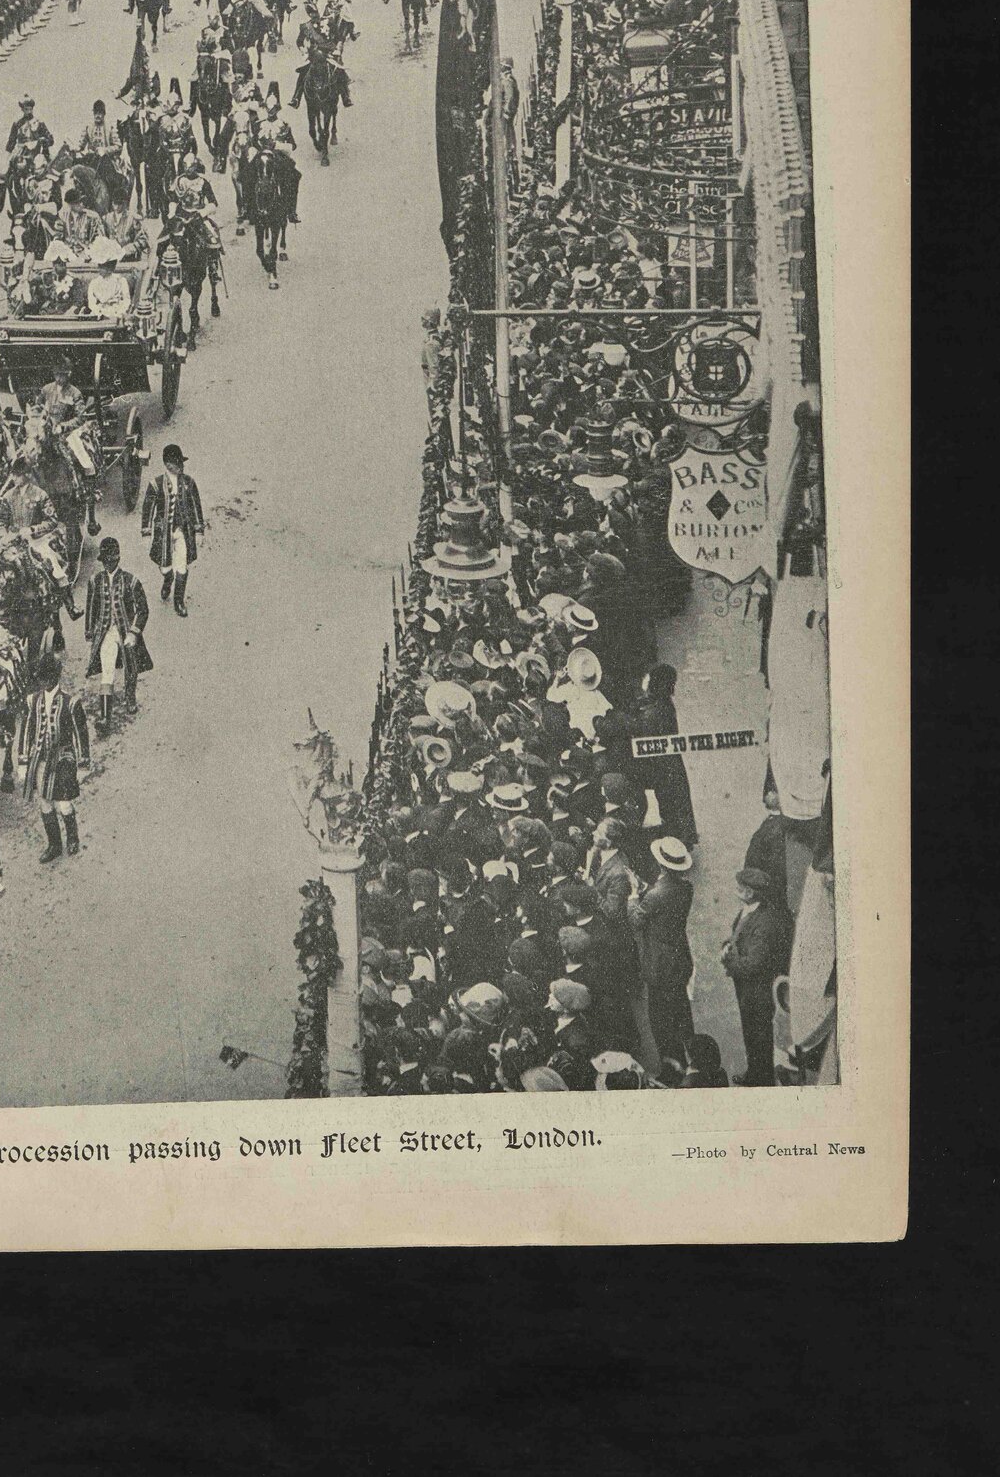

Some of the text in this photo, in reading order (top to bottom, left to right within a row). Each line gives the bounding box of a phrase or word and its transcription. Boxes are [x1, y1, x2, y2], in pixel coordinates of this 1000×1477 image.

[673, 462, 763, 491] BASS
[680, 498, 694, 515] &
[674, 522, 764, 539] BURTON
[636, 729, 759, 756] KEEP TO THE RIGHT.
[129, 1138, 222, 1164] passing
[239, 1136, 302, 1158] down
[320, 1133, 382, 1159] Fleet
[400, 1131, 483, 1153] Street,
[503, 1128, 603, 1151] London.
[740, 1145, 757, 1160] by
[766, 1143, 818, 1157] Central
[828, 1142, 866, 1155] News
